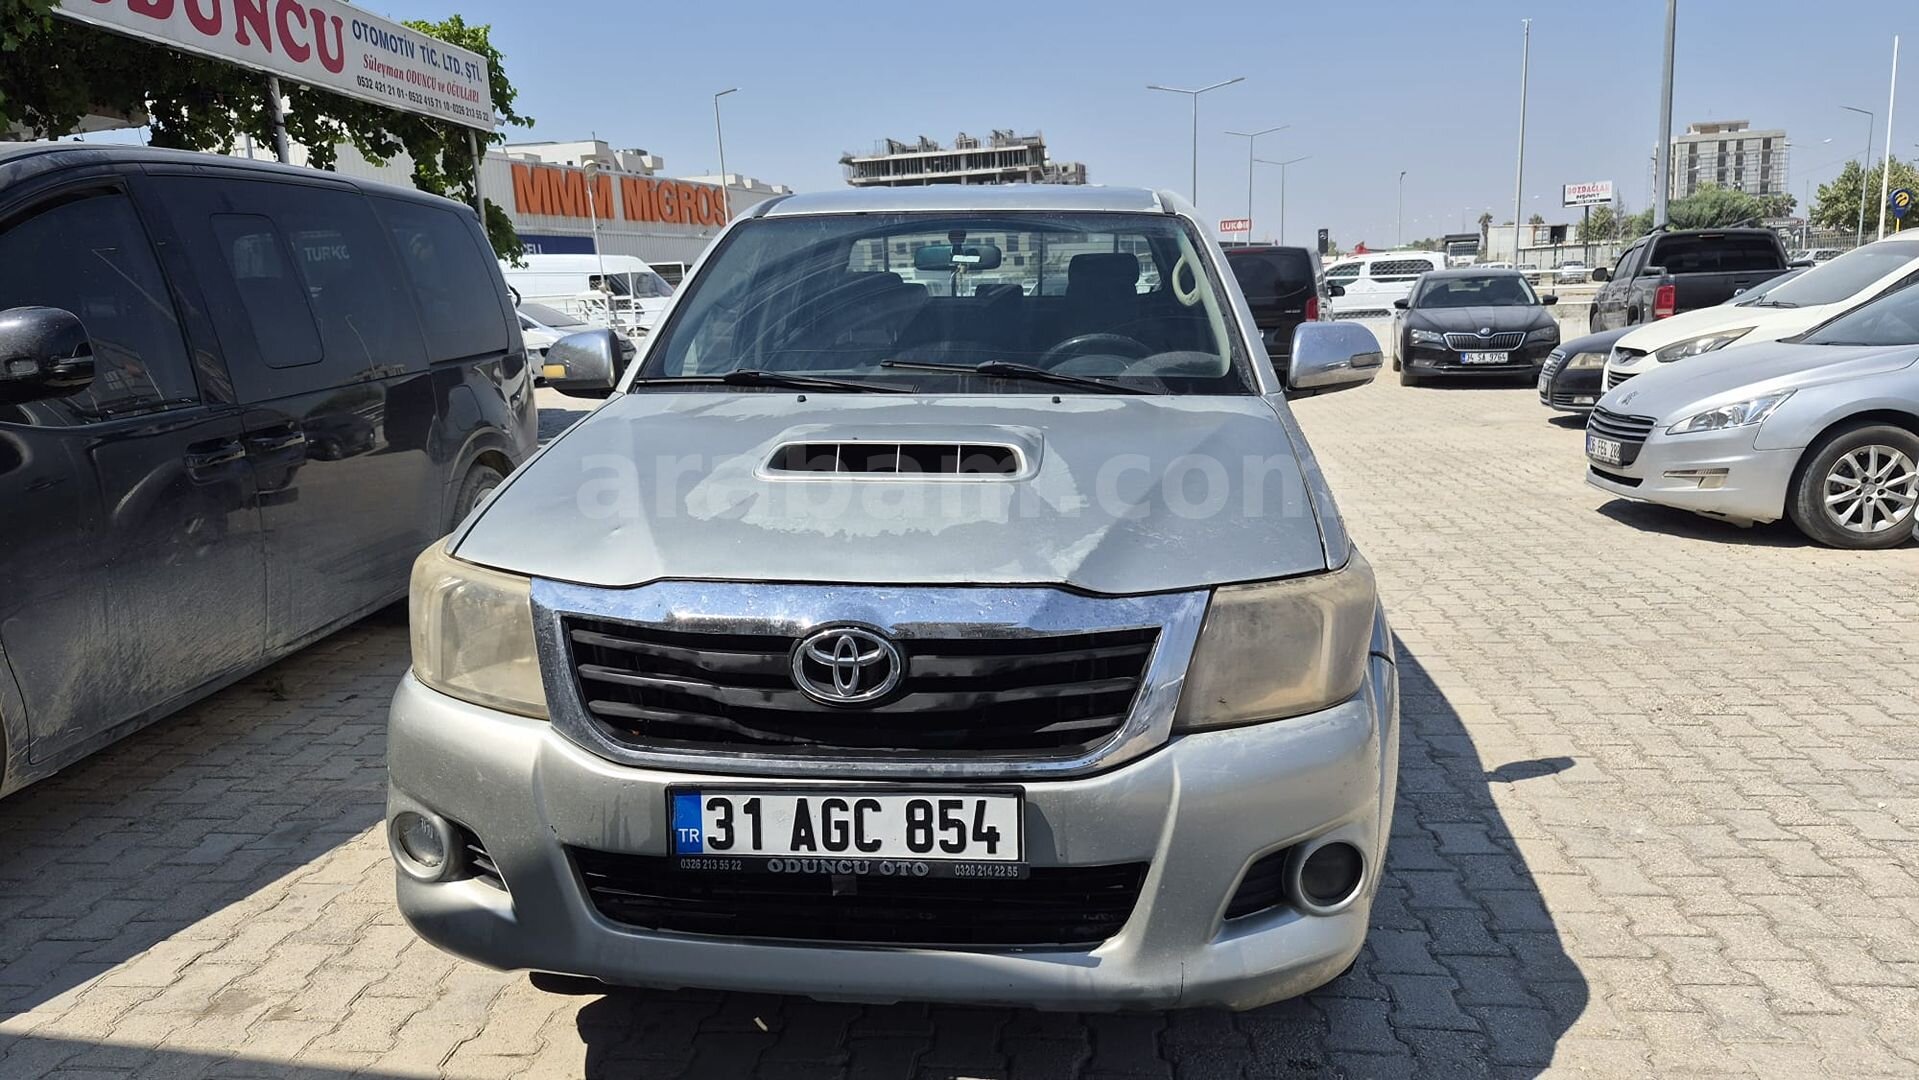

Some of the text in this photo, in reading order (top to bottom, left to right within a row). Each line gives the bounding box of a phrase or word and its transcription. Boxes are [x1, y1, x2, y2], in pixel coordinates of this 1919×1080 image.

[91, 0, 345, 73] UNCU
[352, 19, 483, 84] OTOMOTİV TİC. LTD. ŞTİ.
[356, 74, 374, 90] 0532
[375, 80, 387, 94] 421
[388, 84, 396, 96] 21
[397, 87, 405, 99] 01
[408, 91, 423, 105] 0532
[424, 96, 434, 108] 415
[363, 53, 480, 104] Süleyman ODUNCU ve OĞULLARI
[678, 827, 700, 843] TR
[706, 797, 1001, 855] 31 AGC 854
[680, 859, 742, 871] 0326 213 55 22
[767, 858, 930, 877] ODUNCU OTO
[954, 864, 1018, 877] 0326 214 22 55
